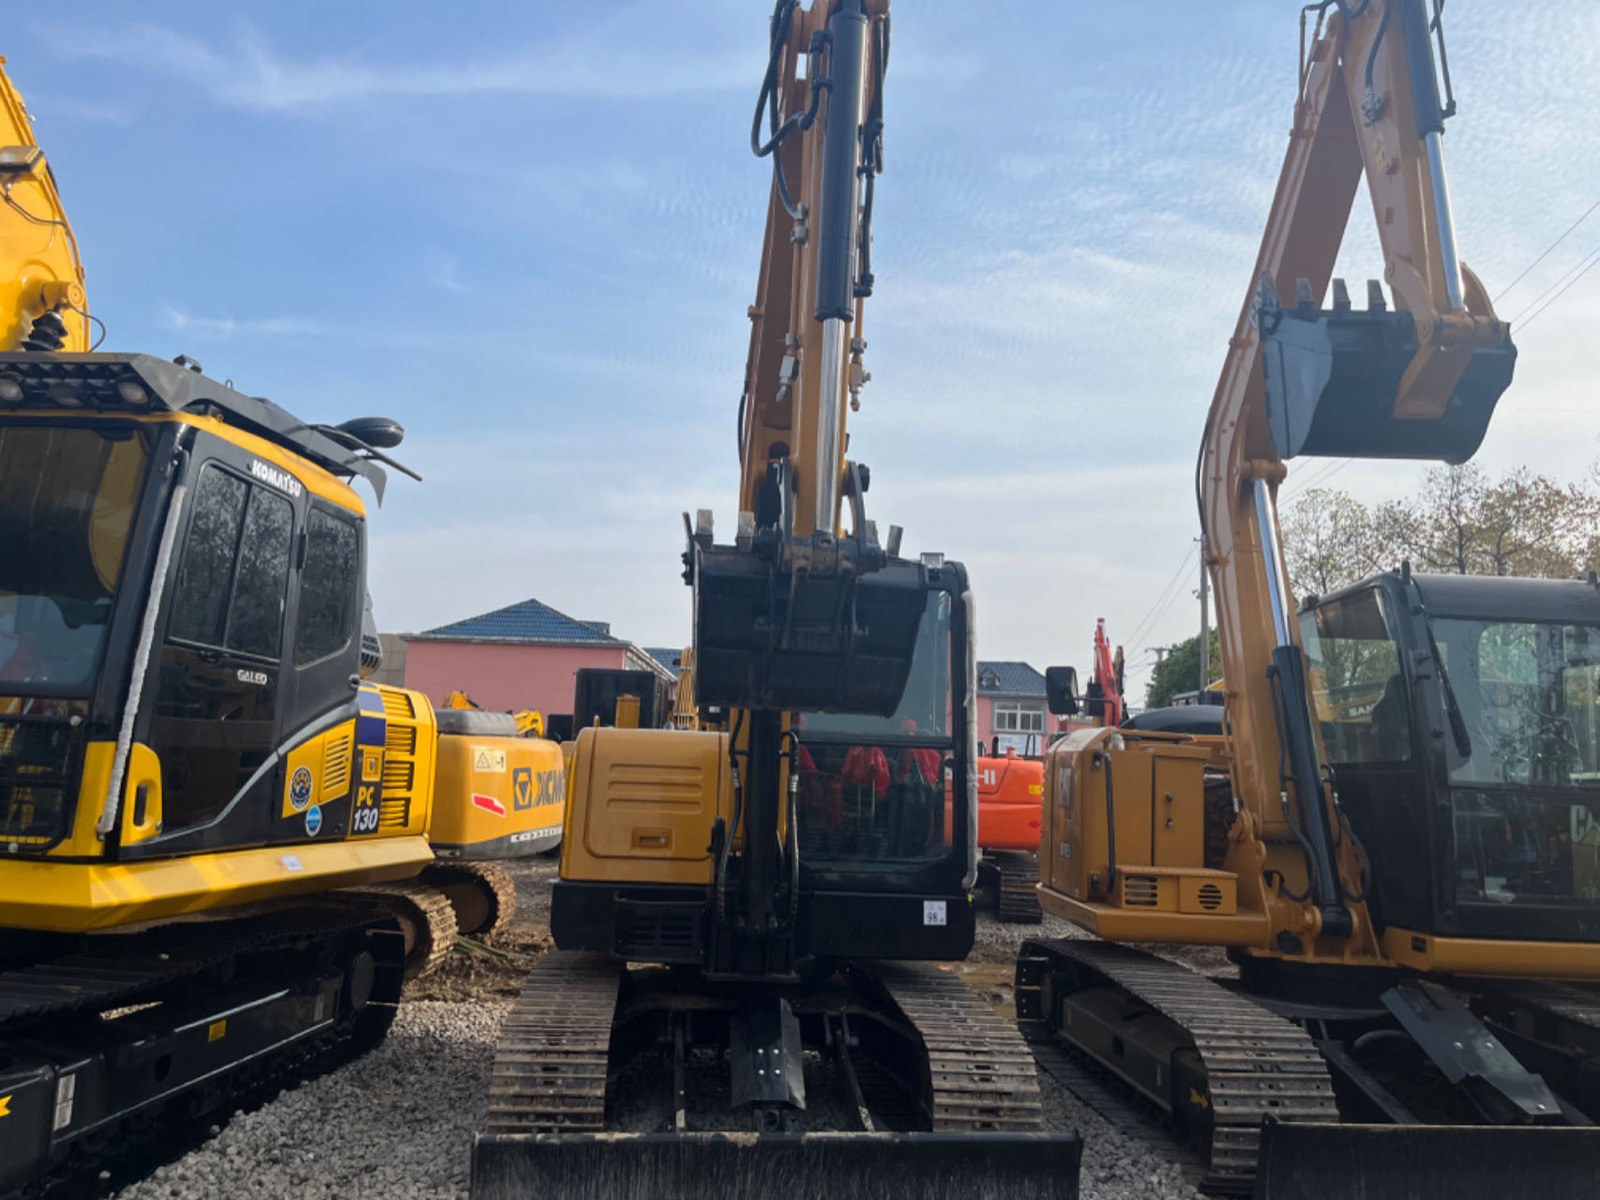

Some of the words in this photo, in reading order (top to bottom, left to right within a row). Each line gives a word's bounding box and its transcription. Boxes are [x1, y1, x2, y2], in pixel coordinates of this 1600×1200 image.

[252, 459, 301, 498] KOMATSU
[357, 786, 374, 807] PC
[354, 808, 378, 831] 130
